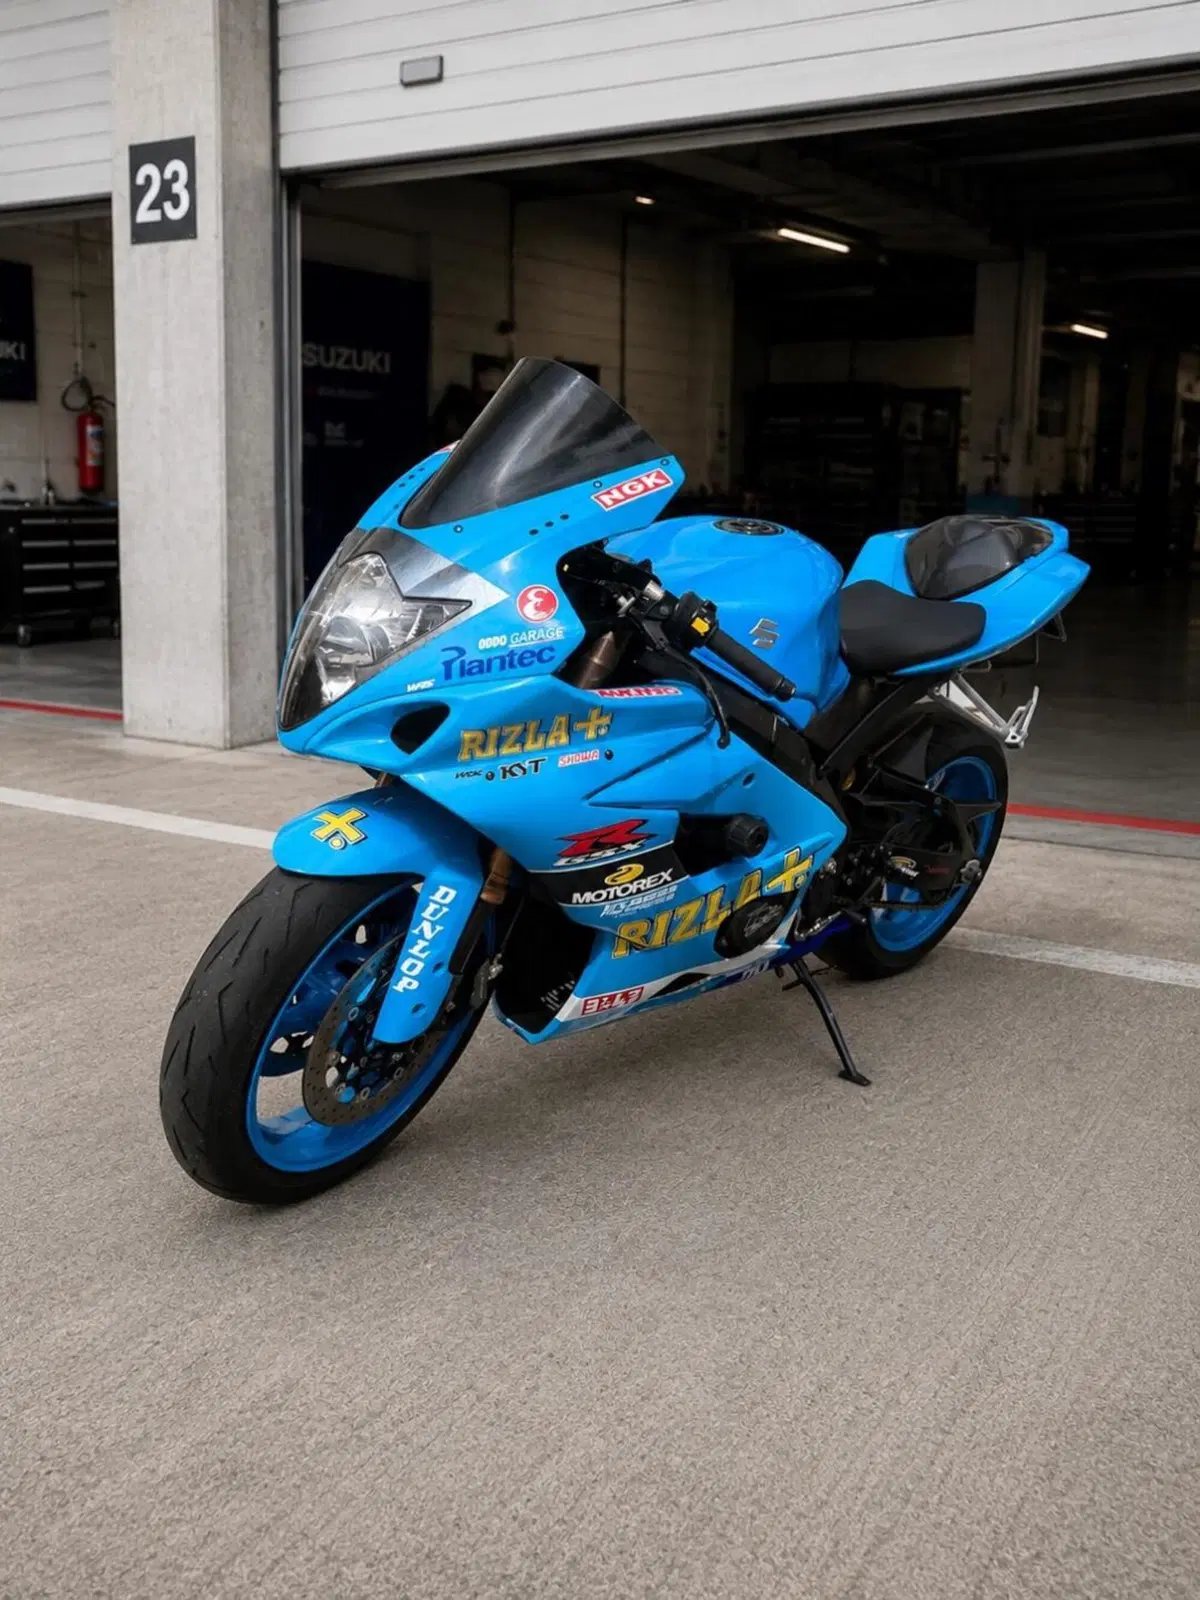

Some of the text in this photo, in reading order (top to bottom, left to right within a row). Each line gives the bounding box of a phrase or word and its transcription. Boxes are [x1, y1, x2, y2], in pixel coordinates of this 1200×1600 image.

[135, 158, 190, 224] 23
[302, 341, 392, 374] SUZUKI
[598, 471, 668, 506] NGK
[509, 626, 566, 648] GARAGE
[440, 645, 556, 681] Plantec
[500, 757, 547, 780] KYT
[571, 868, 673, 904] MOTOREX
[392, 885, 457, 993] DUNLOP
